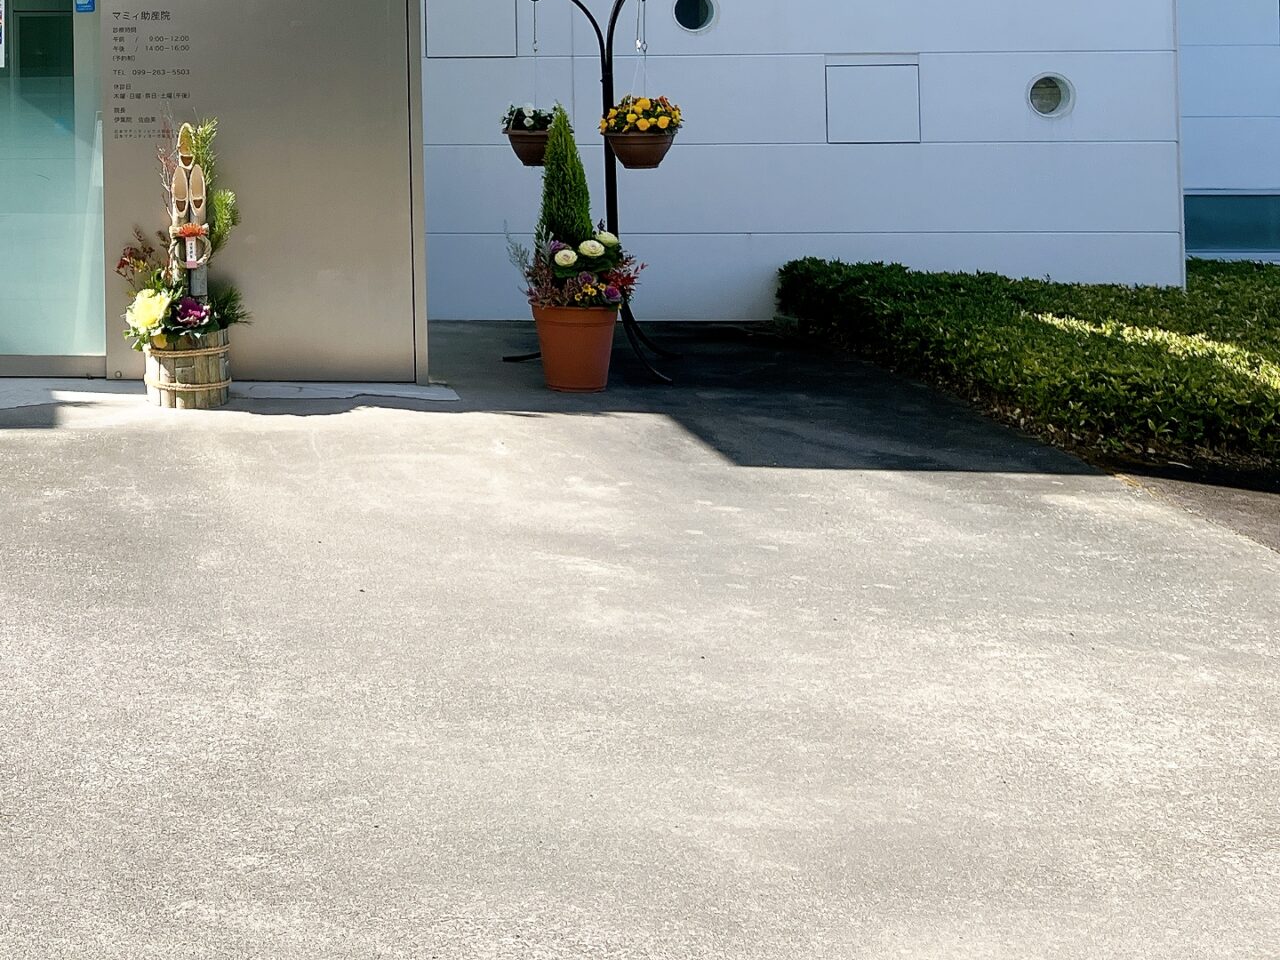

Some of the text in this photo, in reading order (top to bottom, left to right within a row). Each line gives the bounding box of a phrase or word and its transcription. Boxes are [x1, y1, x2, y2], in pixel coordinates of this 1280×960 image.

[112, 10, 171, 21] マミィ助産院
